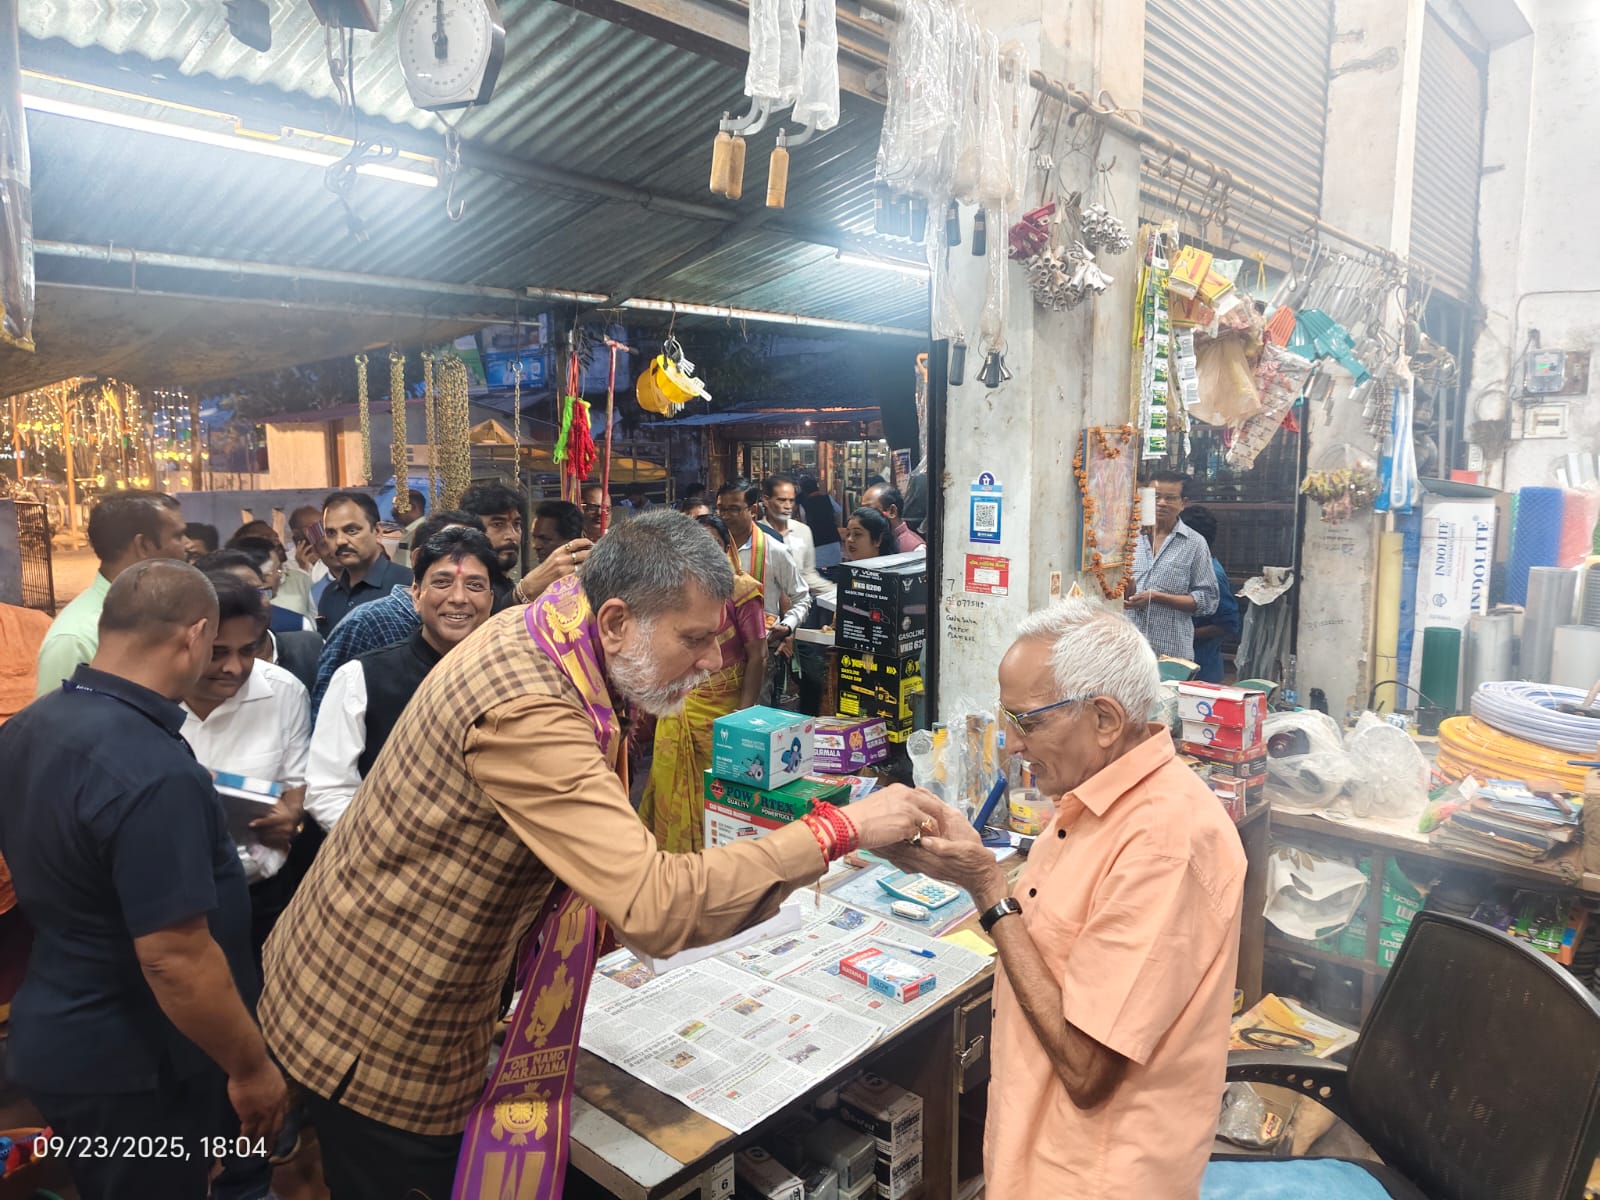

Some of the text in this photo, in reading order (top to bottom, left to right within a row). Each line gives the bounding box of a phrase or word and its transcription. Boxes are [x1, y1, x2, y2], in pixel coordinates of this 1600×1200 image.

[1435, 521, 1450, 577] INDOLITE
[1470, 520, 1489, 611] INDOLITE
[898, 628, 925, 641] GASOLINE
[726, 796, 750, 809] QUALITY
[761, 808, 795, 821] POWERTOOLS
[842, 966, 865, 981] NATARAJ
[510, 1050, 565, 1070] OM NAMO
[500, 1059, 566, 1082] NARAYANA
